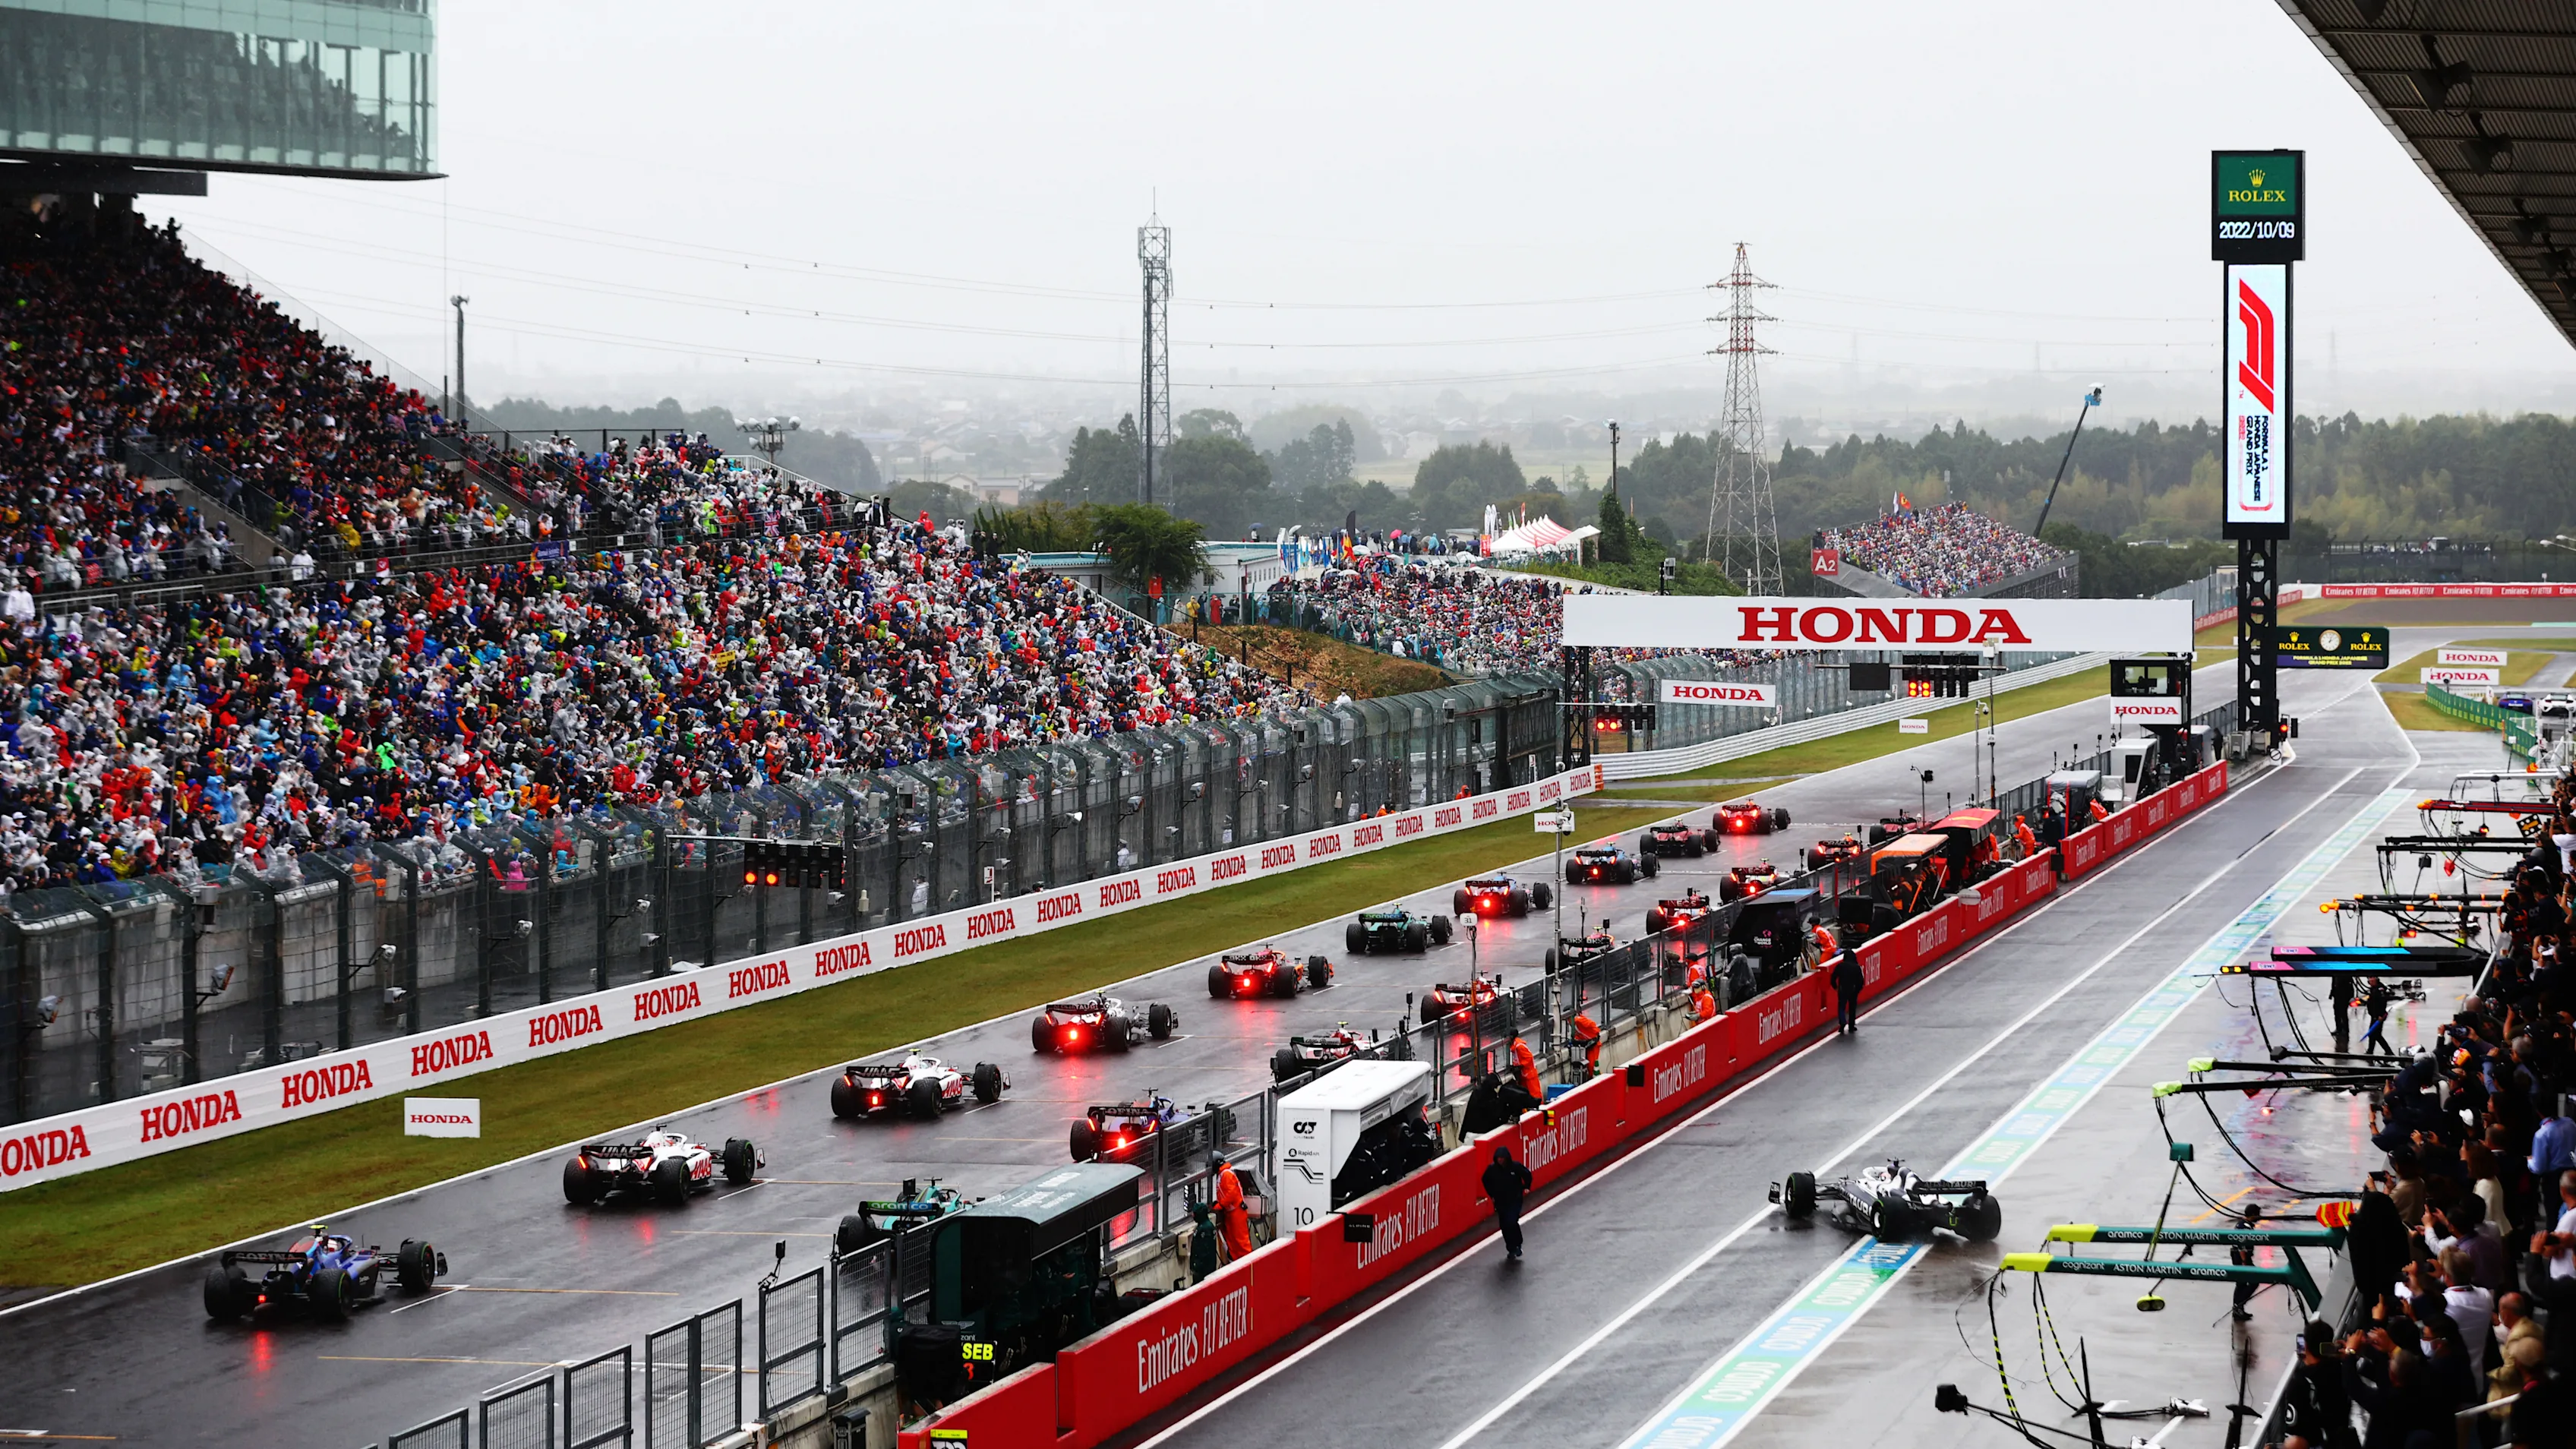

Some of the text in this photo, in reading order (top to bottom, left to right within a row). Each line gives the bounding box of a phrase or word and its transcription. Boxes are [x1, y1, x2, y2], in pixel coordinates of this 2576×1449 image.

[2228, 190, 2286, 202] ROLEX
[2219, 221, 2295, 239] 2022/10/09
[1814, 555, 1836, 572] A2
[2325, 586, 2353, 595] Emirates
[2385, 586, 2411, 595] Emirates
[2443, 587, 2473, 595] Emirates
[2502, 587, 2530, 595] Emirates
[1738, 607, 2031, 644] HONDA
[2278, 642, 2310, 651] ROLEX
[2445, 653, 2499, 662] HONDA
[2430, 672, 2490, 681] HONDA
[1674, 686, 1764, 702] HONDA
[2116, 706, 2178, 715] HONDA
[1540, 781, 1561, 802] HONDA
[1571, 772, 1592, 791] HONDA
[1473, 799, 1497, 819] HONDA
[1508, 792, 1530, 810] HONDA
[1396, 816, 1423, 837] HONDA
[1435, 807, 1461, 827] HONDA
[1309, 834, 1342, 858] HONDA
[1355, 825, 1383, 847] HONDA
[1261, 844, 1296, 869] HONDA
[1211, 855, 1247, 882] HONDA
[1157, 867, 1196, 894] HONDA
[1100, 879, 1141, 908] HONDA
[1037, 893, 1082, 923] HONDA
[968, 908, 1015, 940] HONDA
[894, 924, 946, 957] HONDA
[1917, 925, 1934, 957] Emirates
[816, 942, 872, 977] HONDA
[729, 960, 791, 998] HONDA
[634, 981, 701, 1021] HONDA
[529, 1005, 603, 1048] HONDA
[1759, 1007, 1782, 1046] Emirates
[412, 1031, 494, 1077] HONDA
[863, 1067, 901, 1077] HAAS
[1654, 1062, 1682, 1104] Emirates
[1690, 1043, 1706, 1085] BETTER
[281, 1059, 373, 1109] HONDA
[942, 1077, 963, 1099] HAAS
[140, 1090, 242, 1142] HONDA
[411, 1114, 472, 1124] HONDA
[1523, 1126, 1558, 1172] Emirates
[1569, 1105, 1587, 1153] BETTER
[0, 1125, 91, 1177] ONDA
[598, 1147, 643, 1157] HAAS
[1294, 1208, 1314, 1226] 10
[1357, 1182, 1440, 1271] Emirates FLY BETTER
[2158, 1231, 2183, 1239] STON
[2185, 1232, 2220, 1240] MARTIN
[2227, 1233, 2269, 1242] cognizant
[2063, 1261, 2227, 1277] cognizant ASTON MARTIN aramco
[1138, 1285, 1248, 1394] Emirates FLY BETTER
[962, 1343, 994, 1360] SEB
